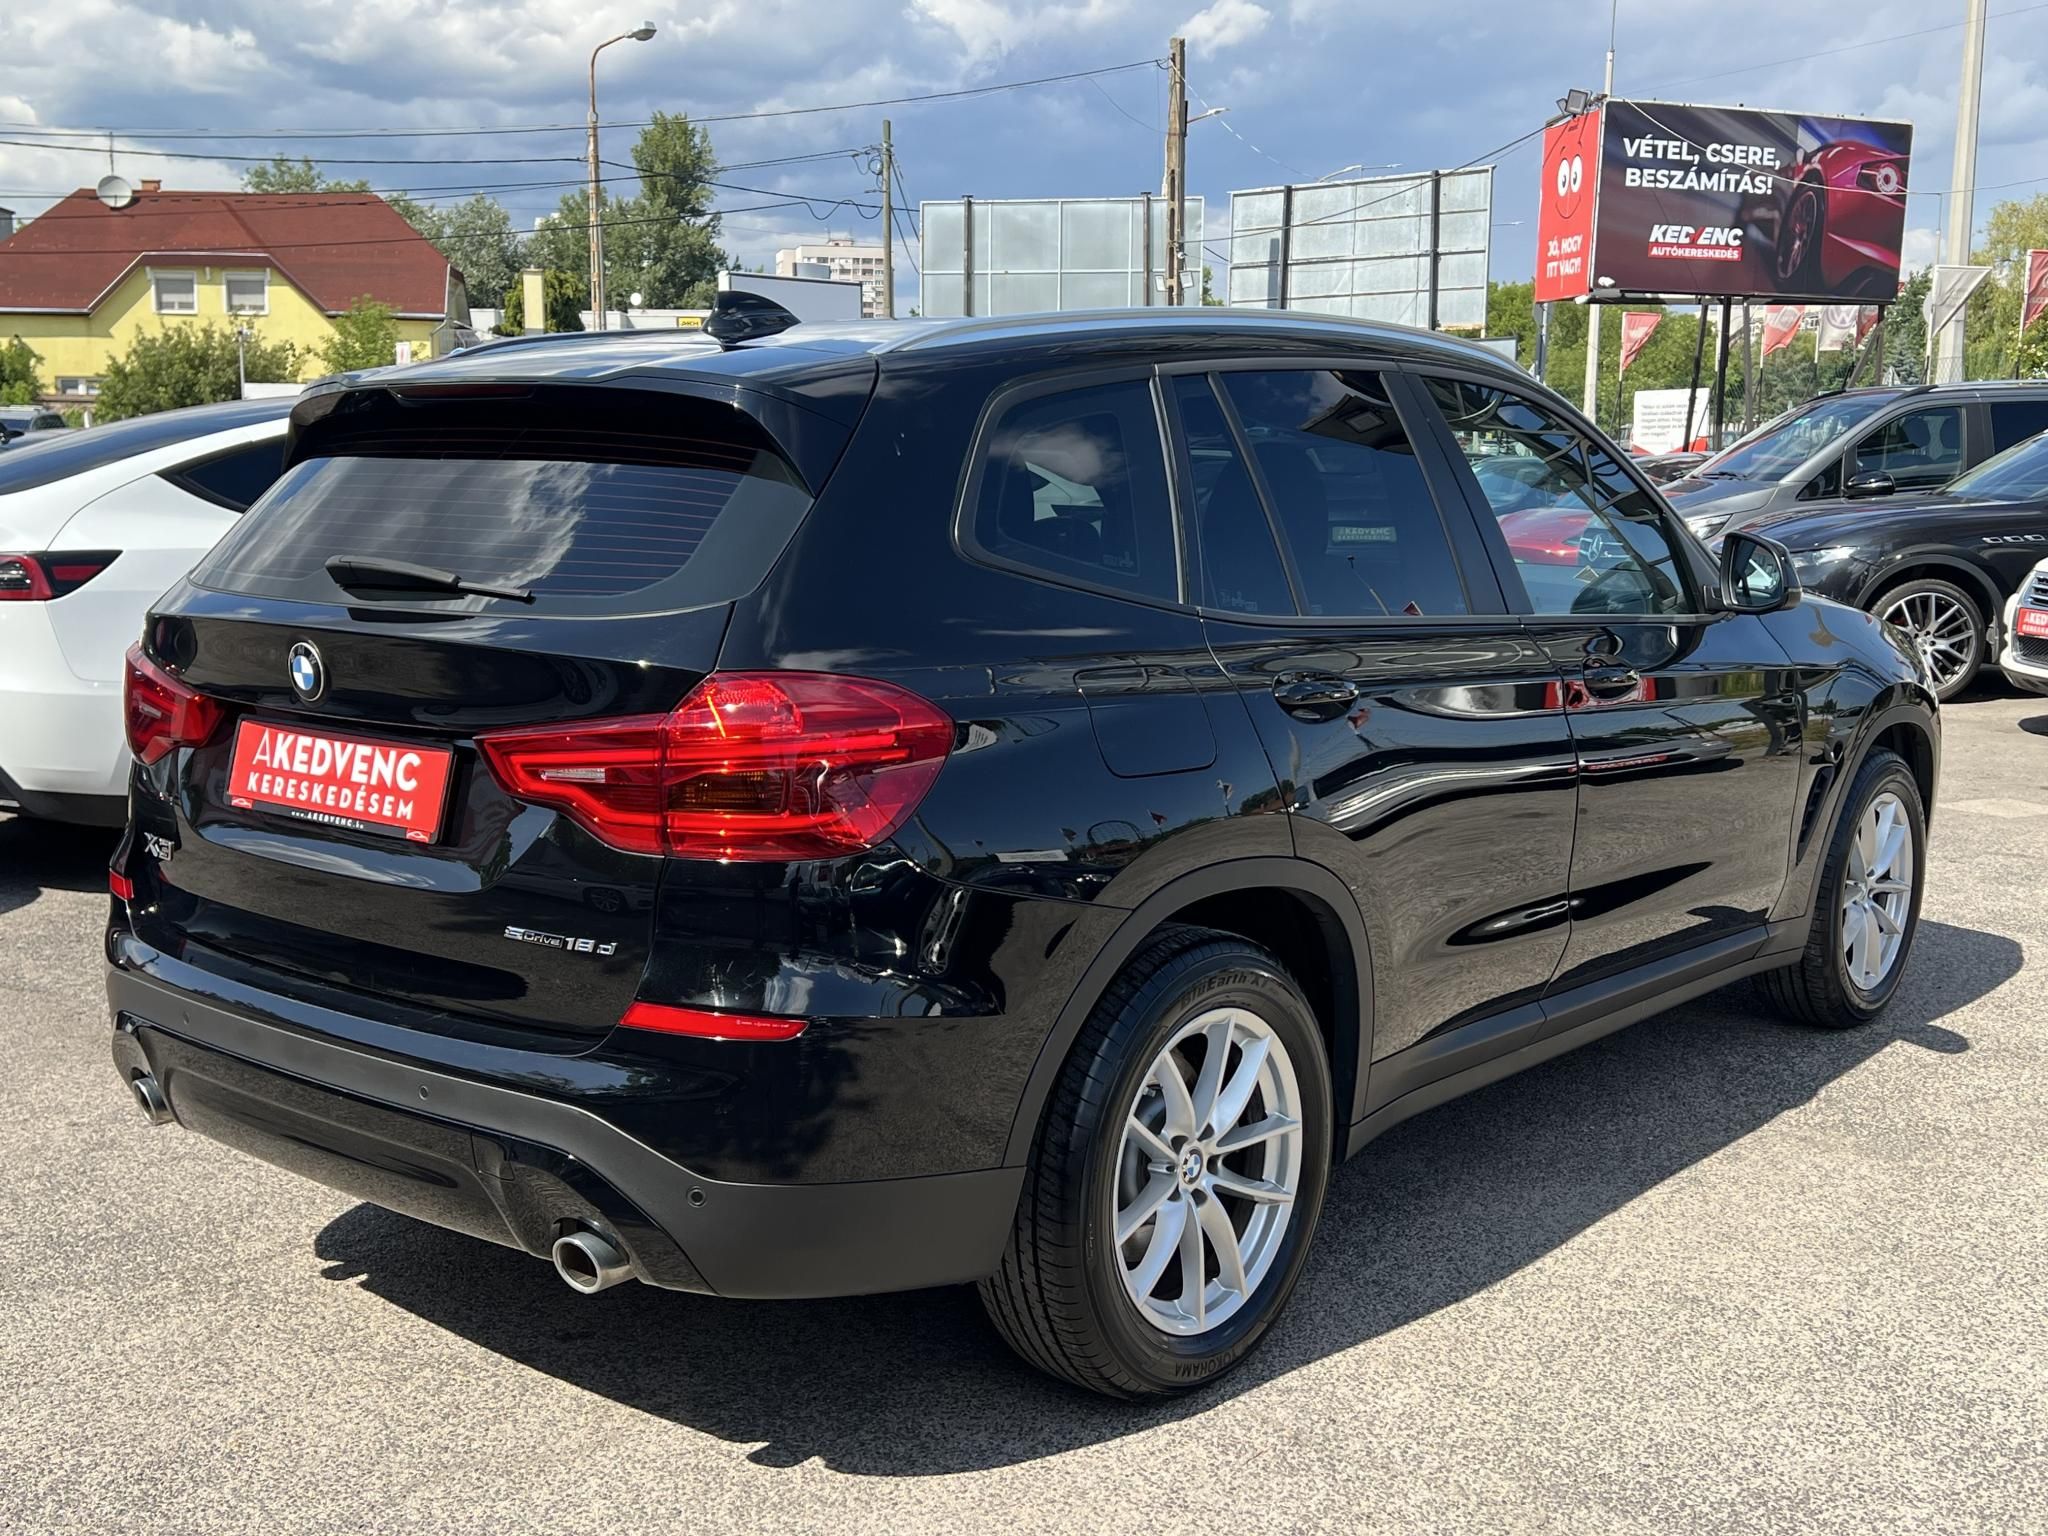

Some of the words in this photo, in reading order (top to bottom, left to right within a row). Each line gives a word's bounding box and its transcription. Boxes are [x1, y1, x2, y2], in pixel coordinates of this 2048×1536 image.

[1622, 134, 1700, 165] VÉTEL,
[1705, 143, 1781, 170] CSERE,
[1625, 166, 1774, 195] BESZÁMÍTÁS!
[1561, 234, 1583, 254] HOGY
[1651, 245, 1739, 259] AUTÓKERESKEDÉS
[2024, 611, 2048, 626] AKED
[252, 728, 422, 792] AKEDVENC
[247, 772, 413, 820] KERESKEDÉSEM
